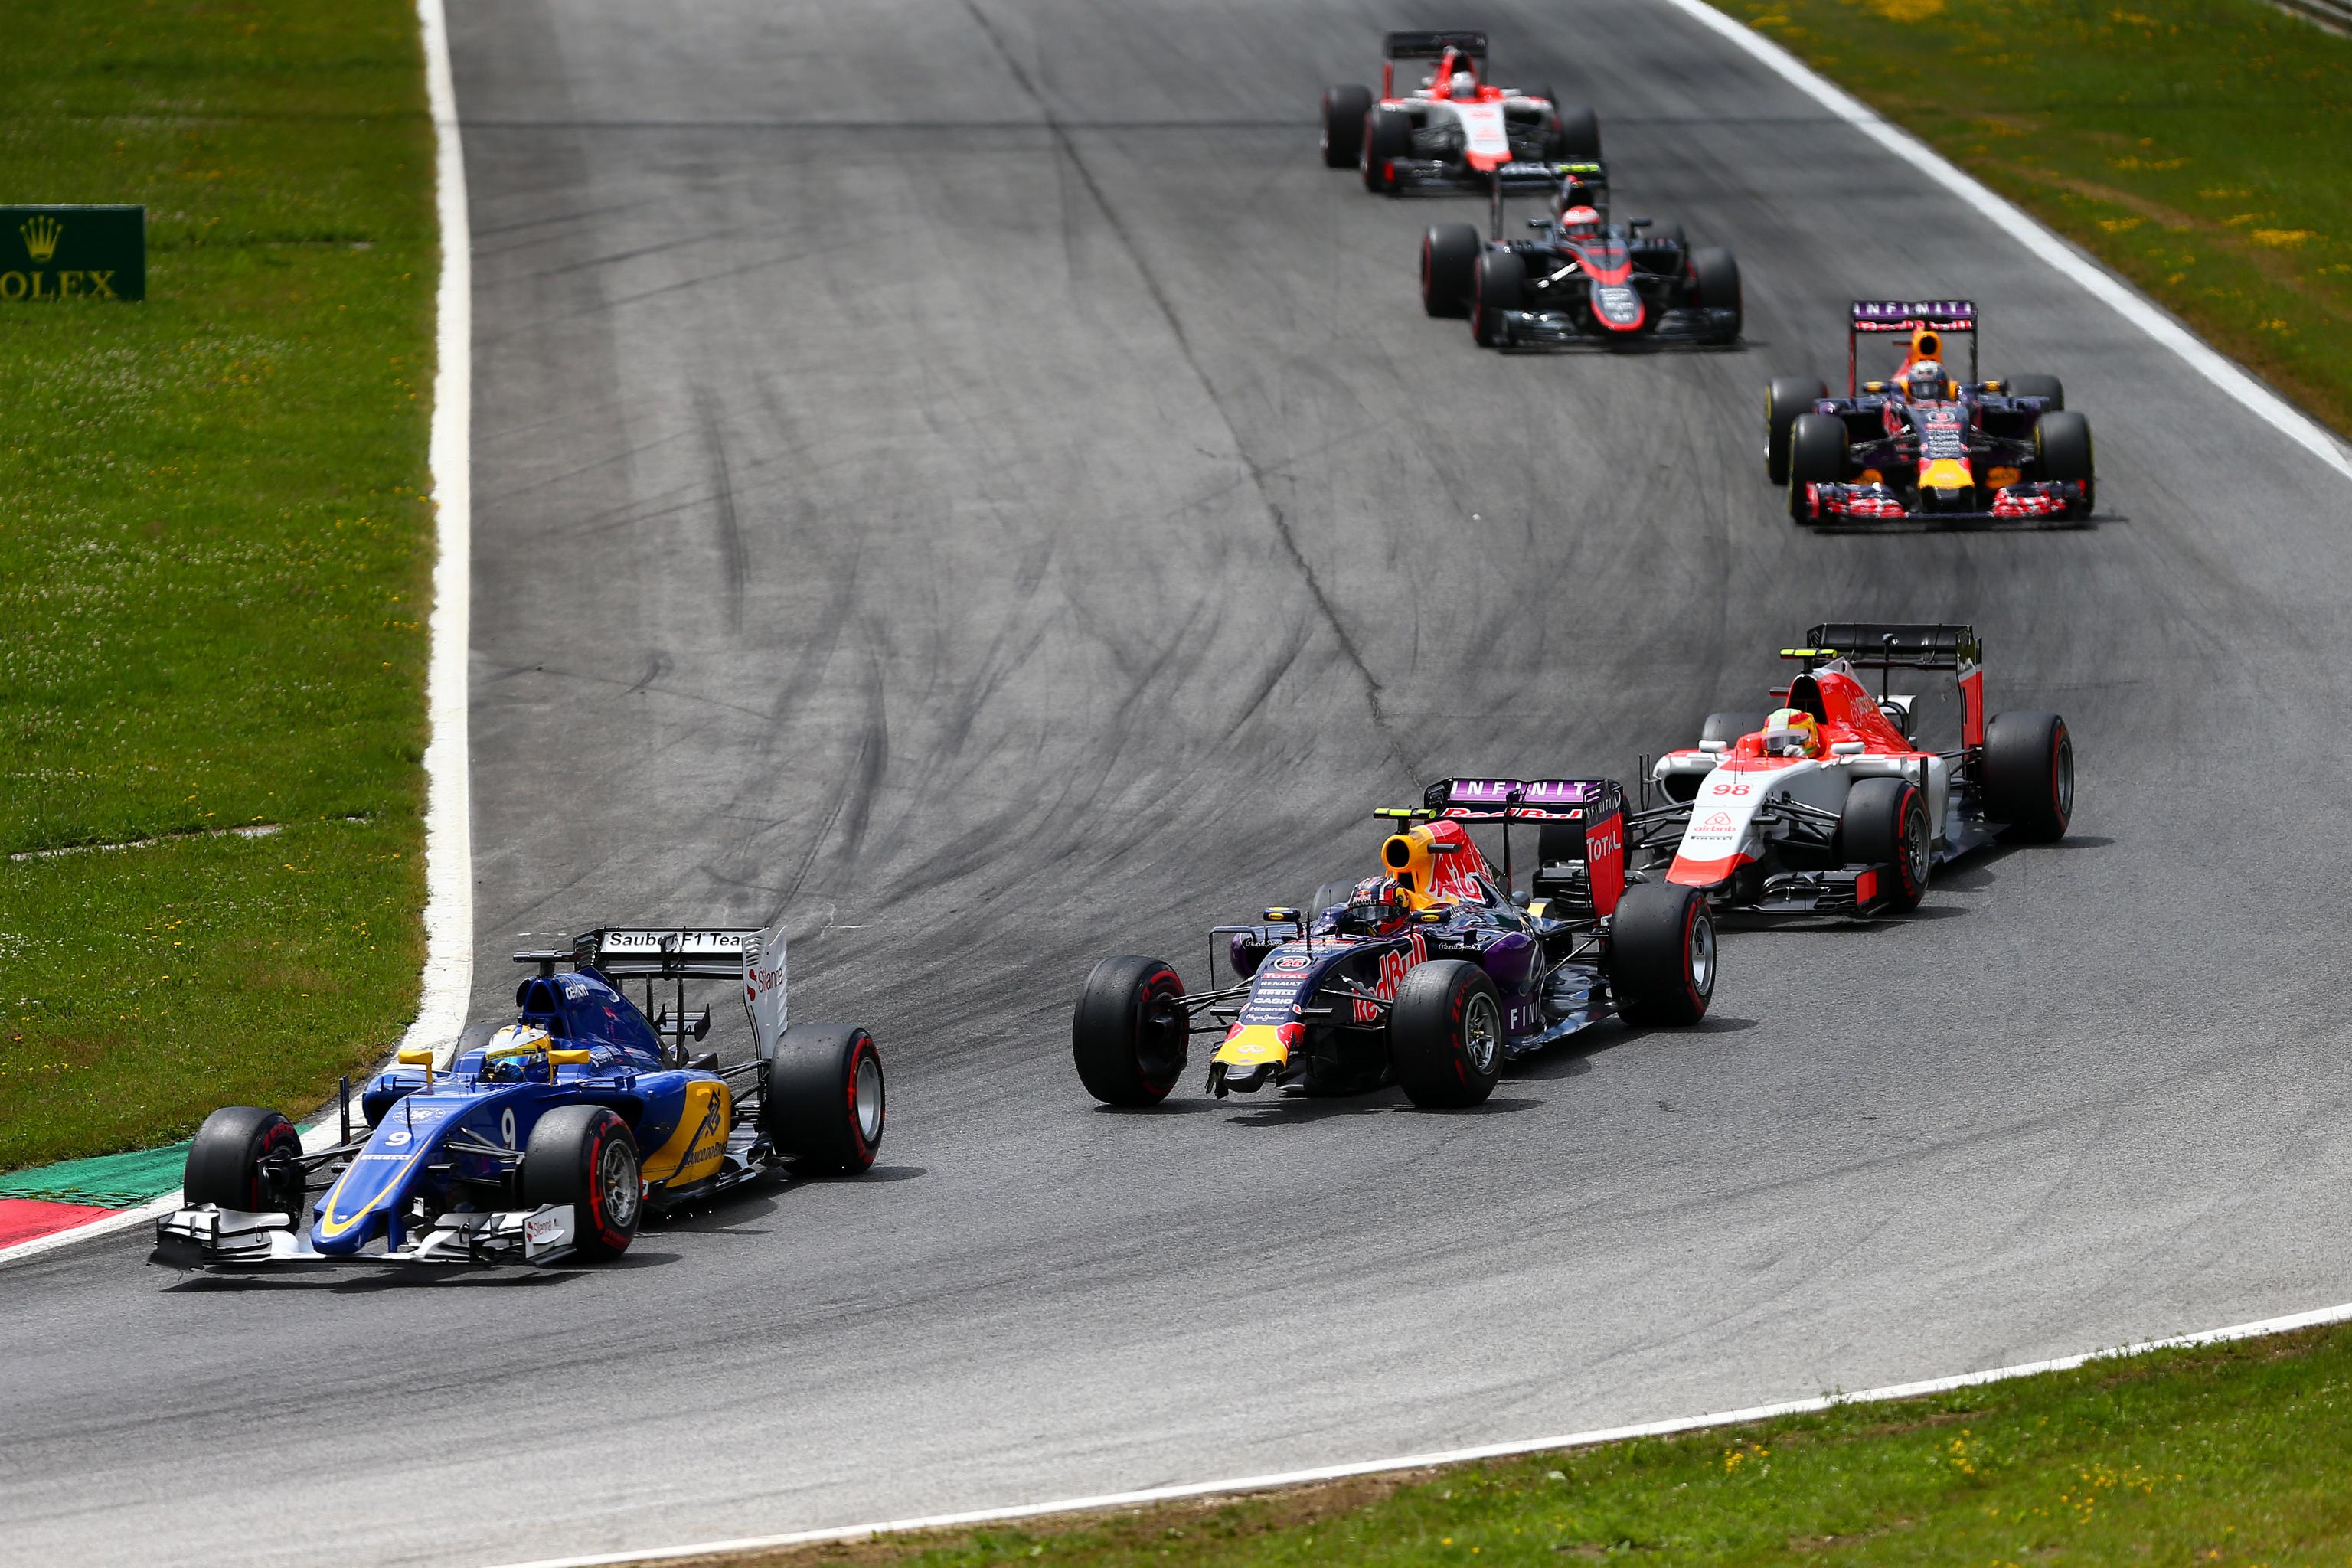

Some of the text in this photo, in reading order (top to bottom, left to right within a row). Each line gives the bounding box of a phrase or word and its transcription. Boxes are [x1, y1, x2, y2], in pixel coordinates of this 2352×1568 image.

[0, 270, 116, 299] OLEX
[1854, 302, 1972, 315] INFINITI
[1450, 780, 1587, 797] INFINIT
[1712, 785, 1751, 795] 98
[1586, 830, 1622, 864] TOTAL
[610, 932, 741, 946] Saub F1 Tea
[1279, 959, 1307, 968] 26
[1510, 1000, 1539, 1031] FINI
[502, 1109, 516, 1151] 9
[384, 1132, 413, 1147] 9
